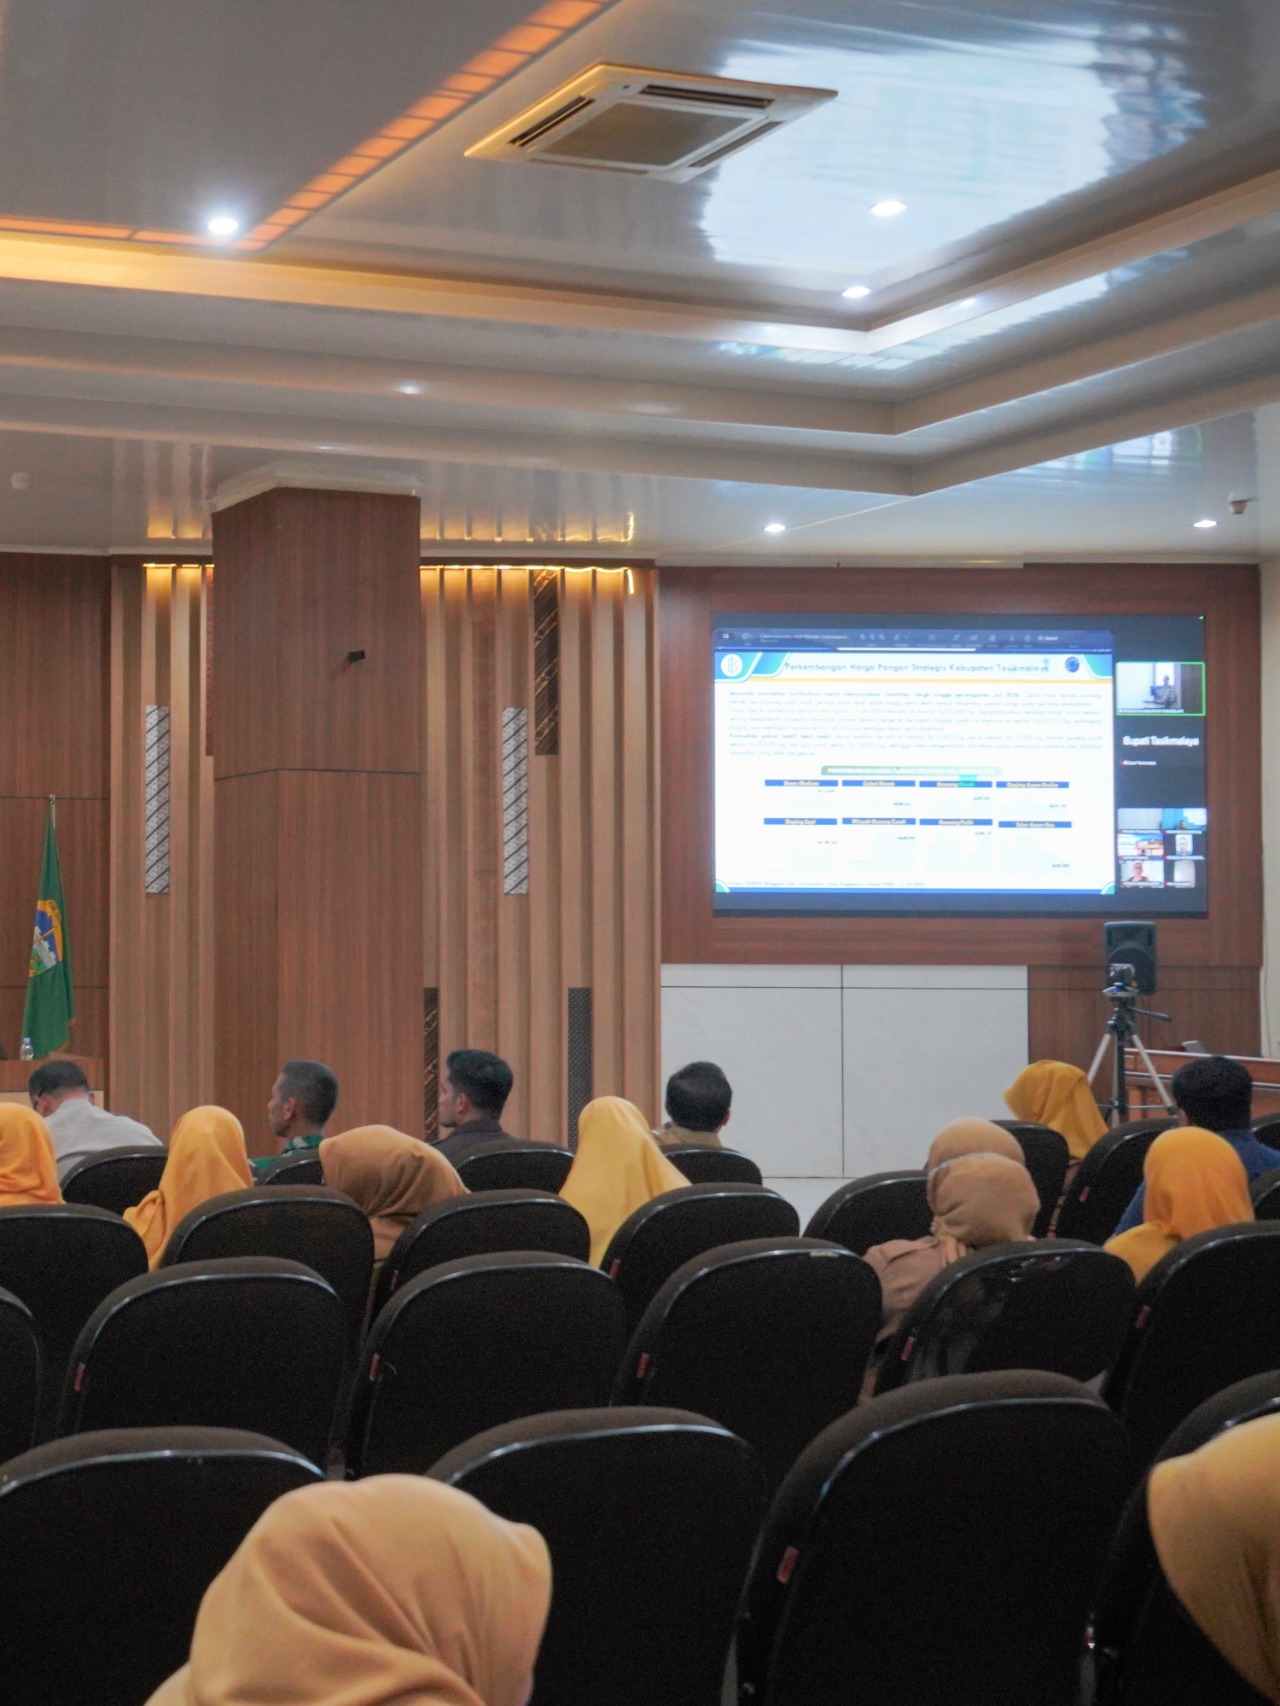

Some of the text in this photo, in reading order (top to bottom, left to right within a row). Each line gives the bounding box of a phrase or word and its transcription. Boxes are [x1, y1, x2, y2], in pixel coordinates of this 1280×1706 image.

[785, 662, 846, 673] Perkembangan
[850, 663, 875, 673] Harga
[878, 663, 908, 673] Pangan
[912, 663, 946, 673] Strategis
[949, 663, 993, 673] Kabupaten
[1122, 735, 1150, 747] Bupati
